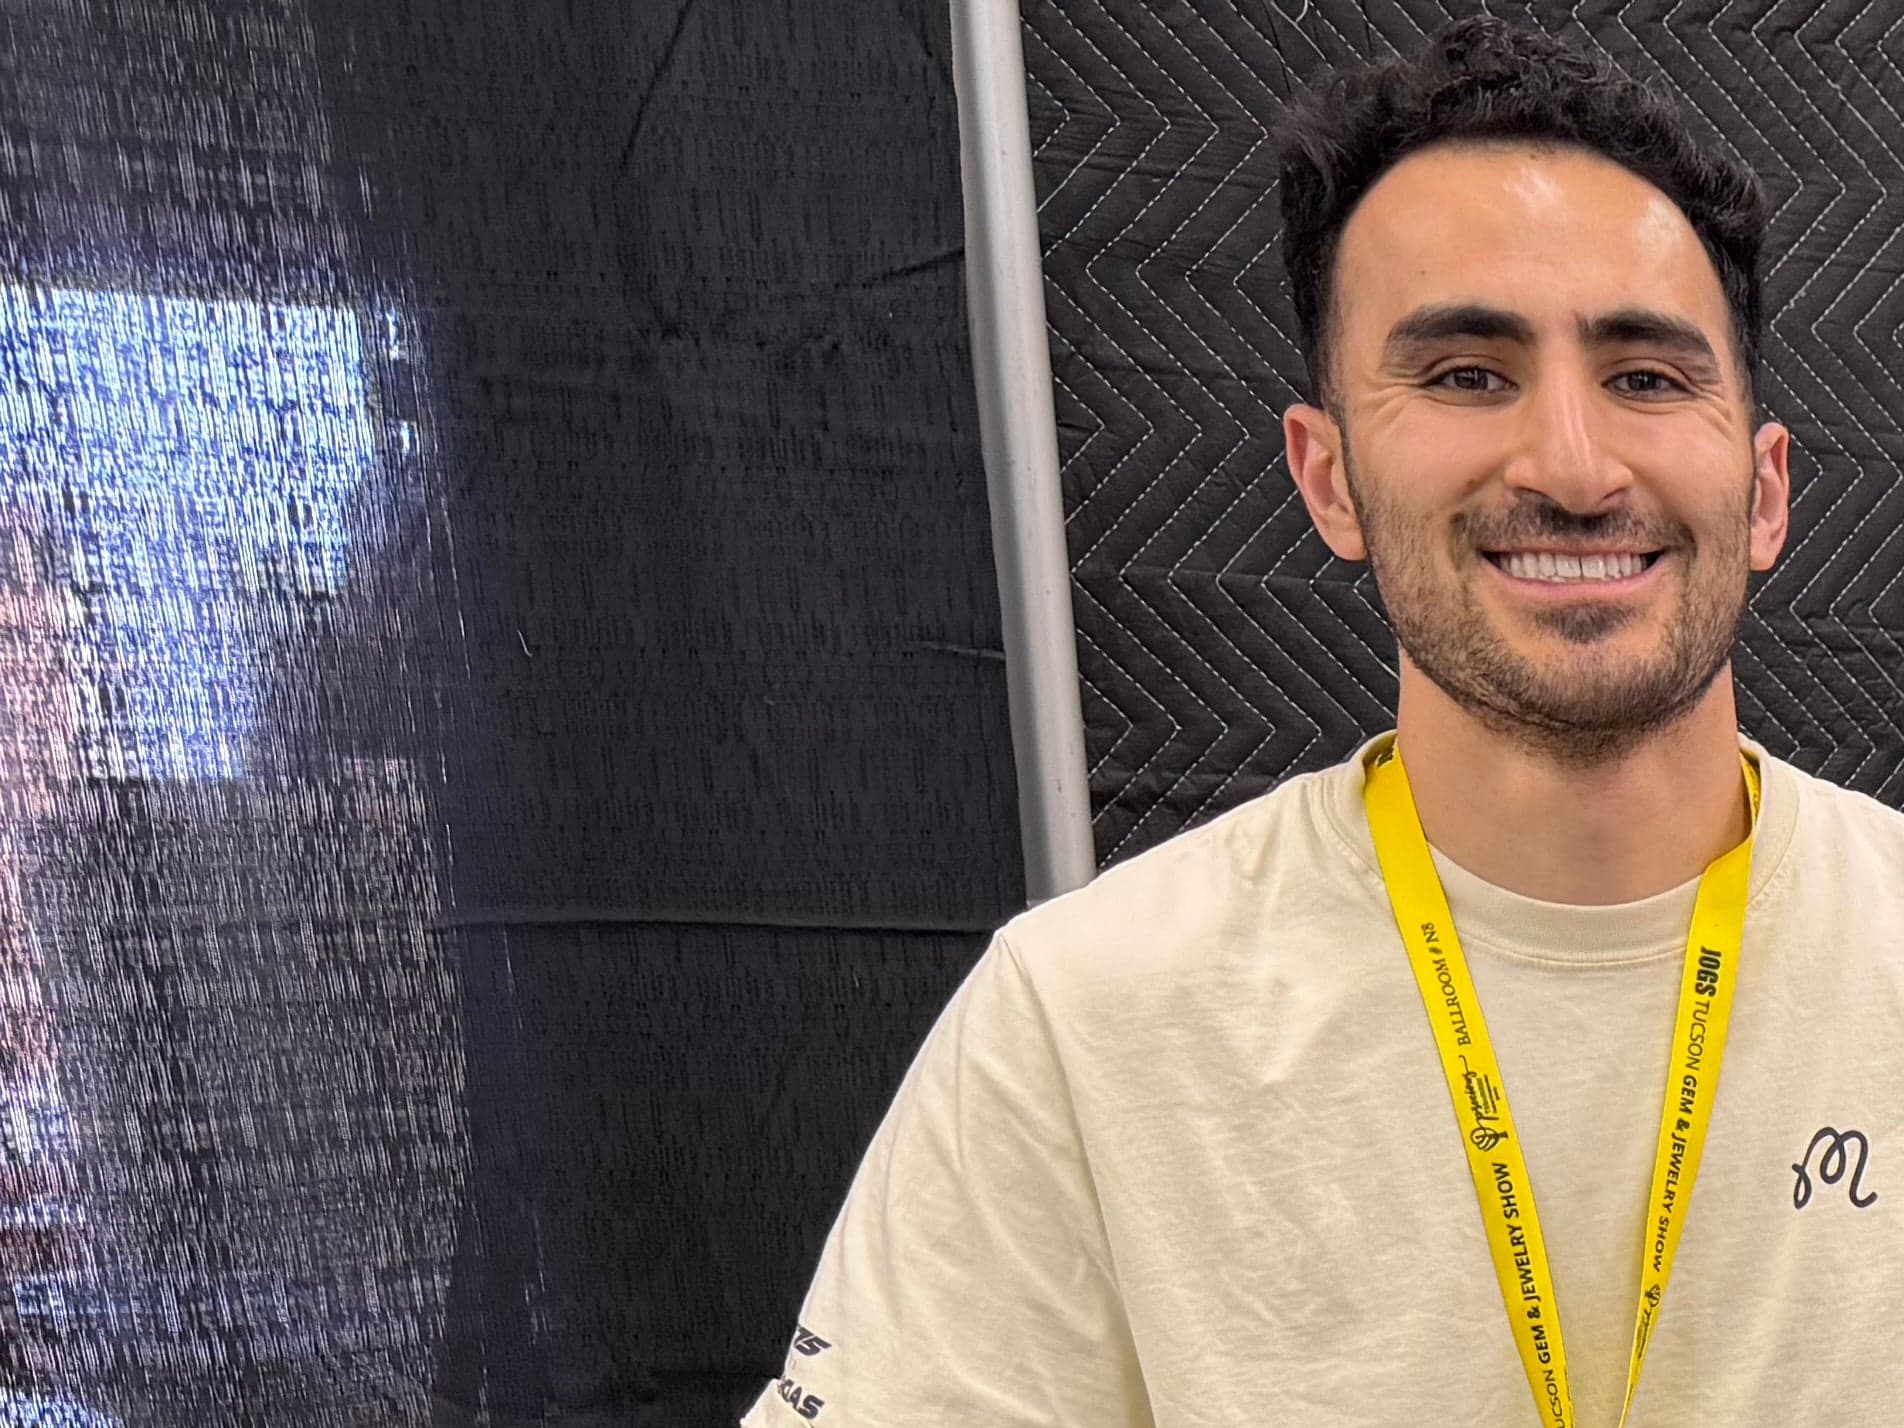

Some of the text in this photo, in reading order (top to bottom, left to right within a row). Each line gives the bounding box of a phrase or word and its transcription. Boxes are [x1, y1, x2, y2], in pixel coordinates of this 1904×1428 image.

[1421, 922, 1438, 943] N8
[1432, 958, 1471, 1047] BALLROOM
[1653, 946, 1722, 1272] JOGS TUCSON GEM & JEWELRY SHOW
[1492, 1162, 1519, 1221] SHOW
[1508, 1224, 1541, 1302] JEWELRY
[1527, 1306, 1541, 1319] &
[1532, 1325, 1552, 1364] GEM
